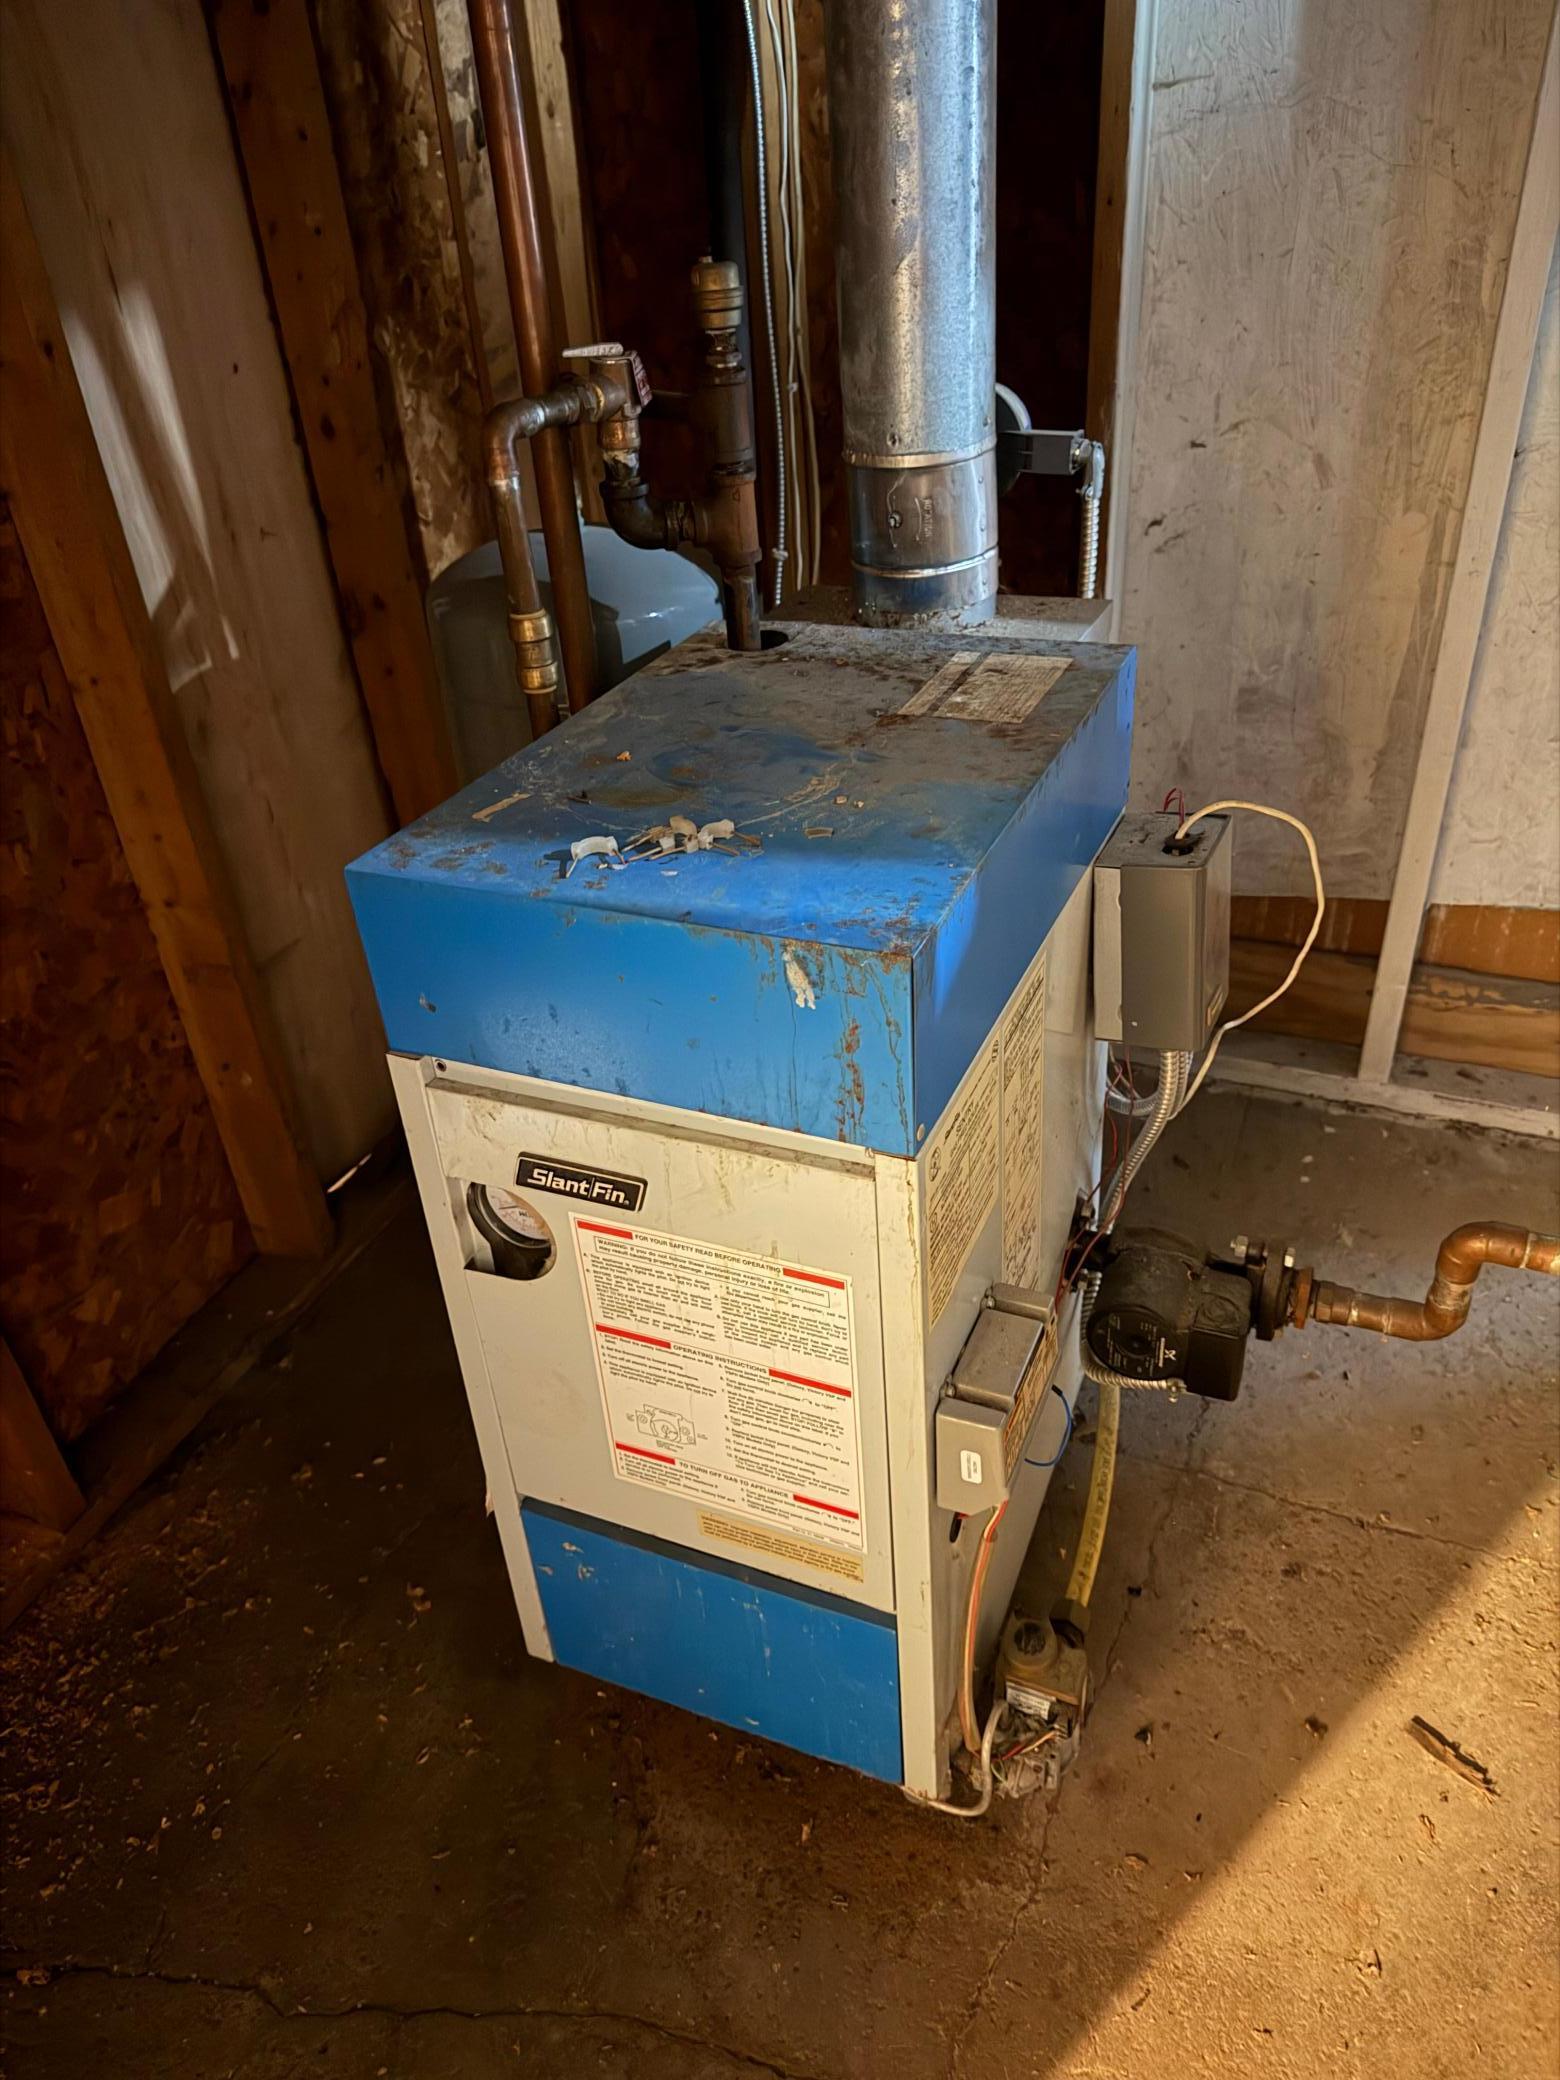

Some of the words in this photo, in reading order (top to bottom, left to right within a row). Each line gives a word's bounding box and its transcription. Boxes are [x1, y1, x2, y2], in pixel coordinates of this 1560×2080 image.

[526, 1167, 589, 1196] Slant
[634, 1233, 648, 1242] FOR
[649, 1237, 667, 1246] YOUR
[668, 1241, 693, 1252] SAFETY
[694, 1247, 712, 1257] READ
[714, 1252, 741, 1263] BEFORE
[742, 1259, 780, 1273] OPERATING
[673, 1344, 713, 1359] OPERATING
[714, 1355, 766, 1374] INSTRUCTIONS
[679, 1461, 688, 1469] TO
[690, 1464, 707, 1474] TURN
[709, 1470, 721, 1478] OFF
[723, 1474, 737, 1483] GAS
[750, 1482, 788, 1498] APPLIANCE
